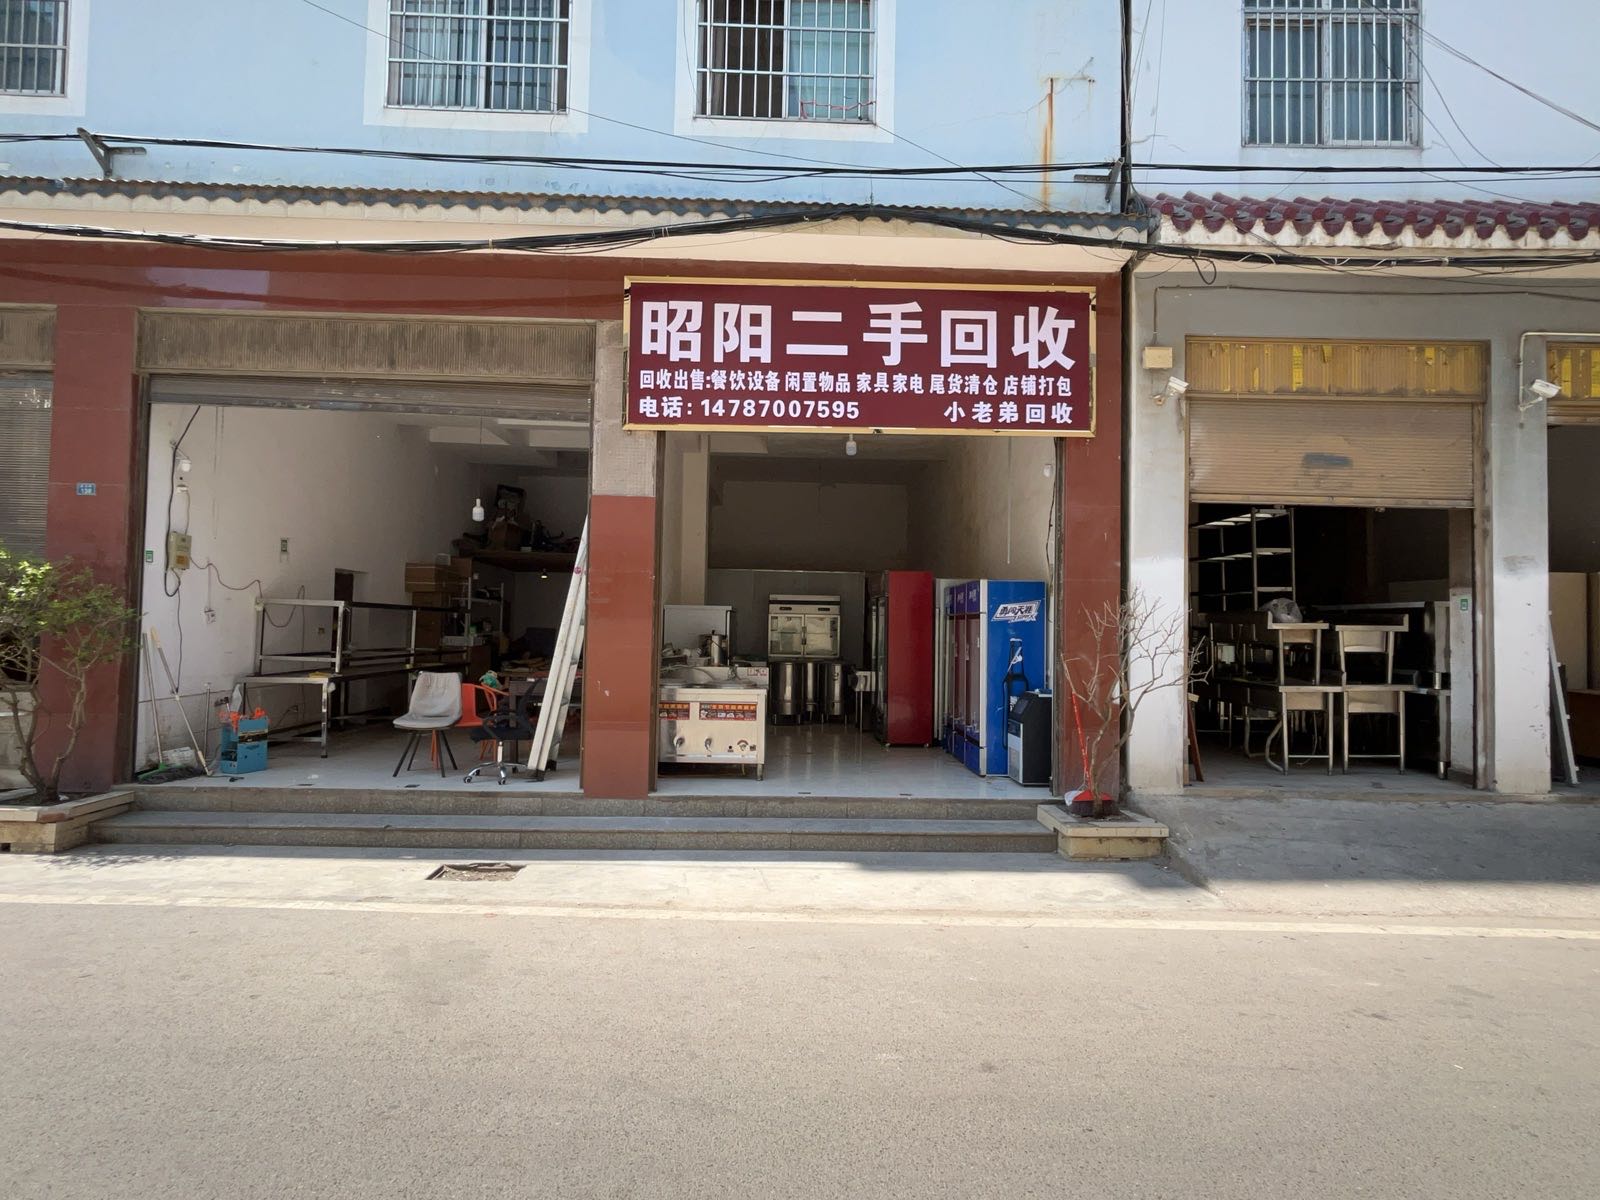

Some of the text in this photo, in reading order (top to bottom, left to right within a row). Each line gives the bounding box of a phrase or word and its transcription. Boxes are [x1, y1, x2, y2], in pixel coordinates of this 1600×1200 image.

[642, 301, 1075, 370] 昭阳二手回收
[640, 369, 1071, 396] 回收出售:餐饮设备 闲置物品 家具家电 尾货清仓 店铺打包
[640, 396, 859, 419] 电话：14787007595
[944, 401, 1072, 423] 小老弟回收
